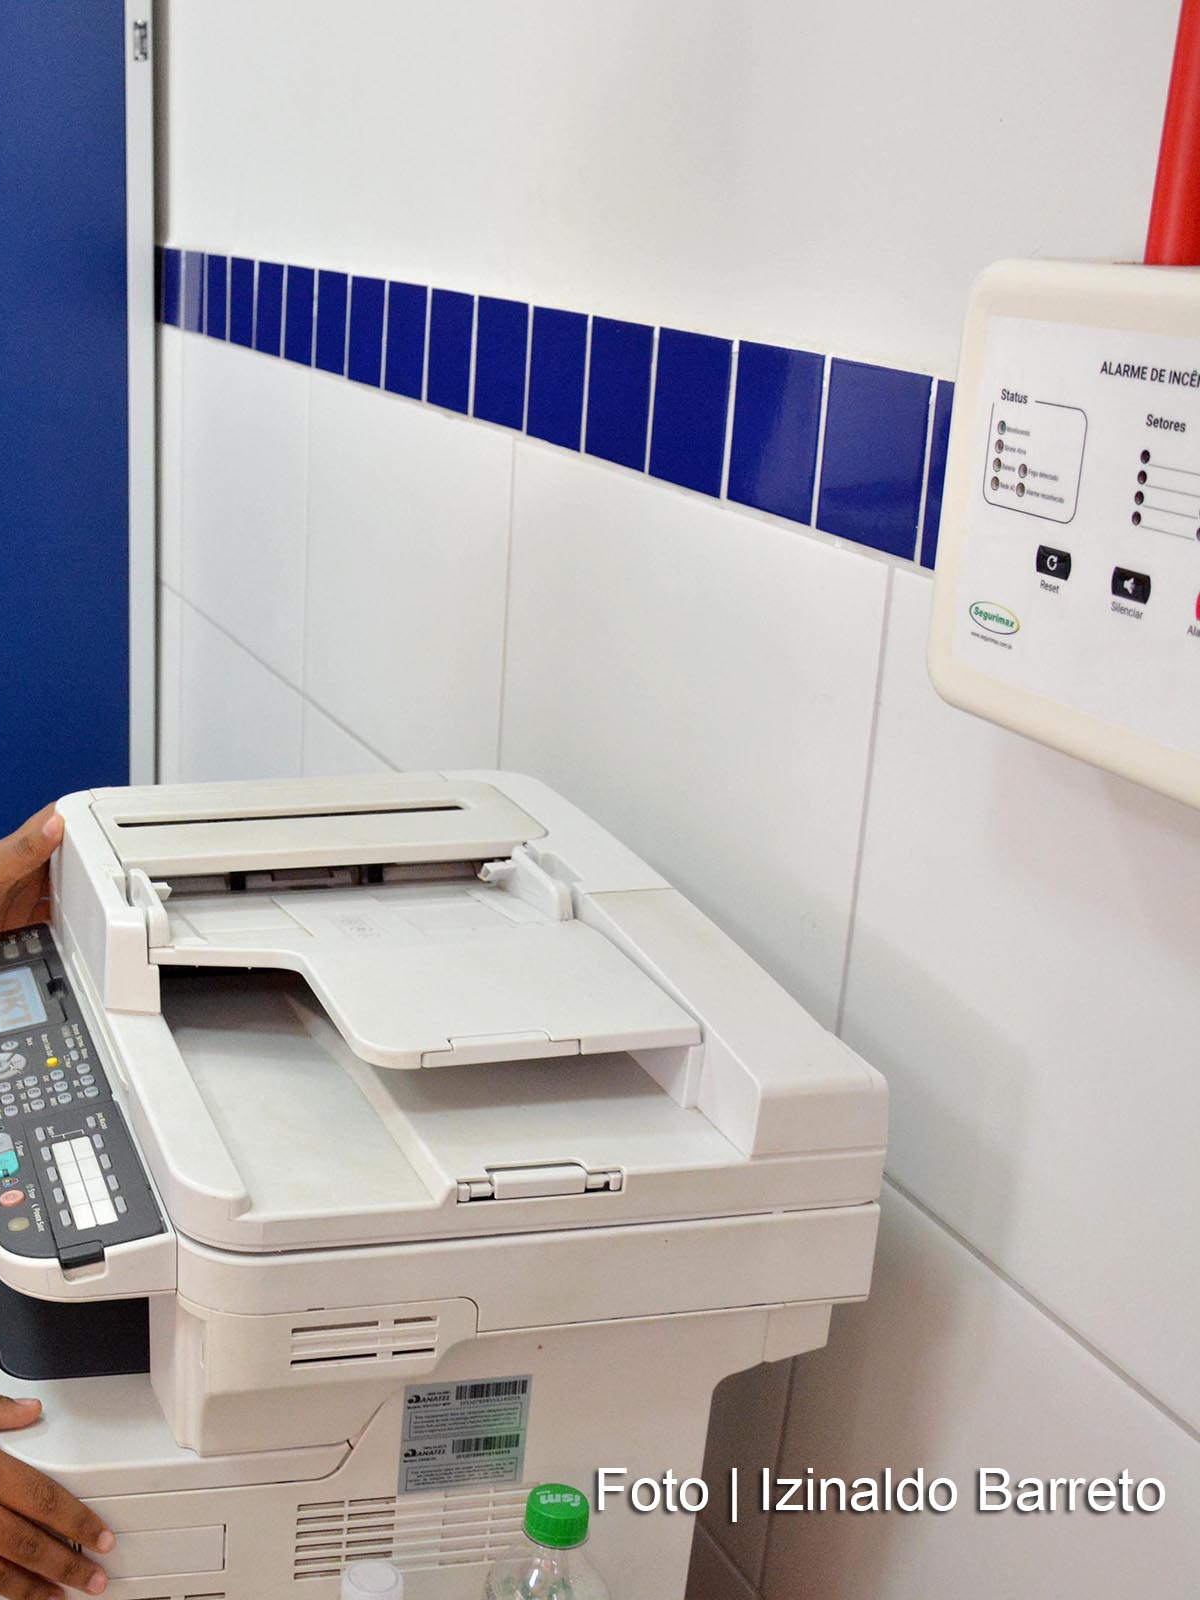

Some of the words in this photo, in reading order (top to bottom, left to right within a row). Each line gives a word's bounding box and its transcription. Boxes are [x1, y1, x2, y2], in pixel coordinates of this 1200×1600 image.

[1100, 360, 1148, 380] ALARME
[1150, 367, 1166, 383] DE
[1001, 388, 1028, 404] Status
[1145, 413, 1186, 433] Setores
[1040, 579, 1060, 593] Reset
[973, 606, 1015, 628] Segurimax
[1110, 601, 1143, 620] Silenciar
